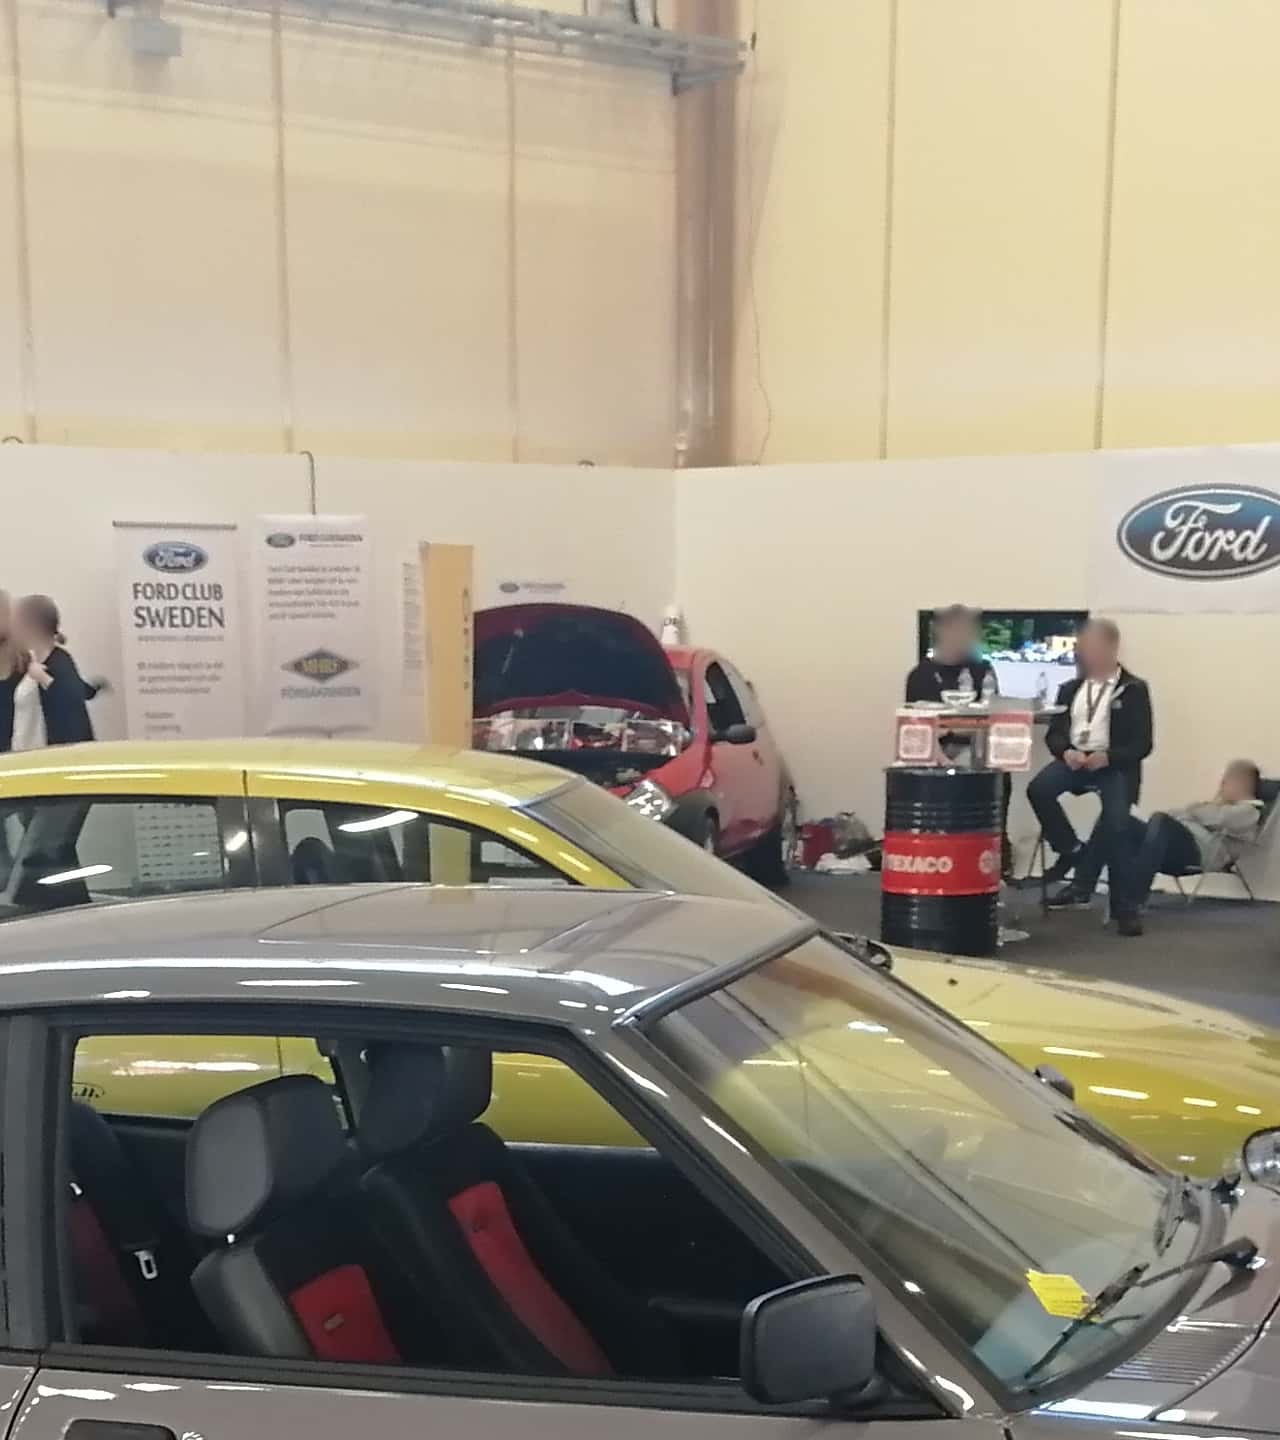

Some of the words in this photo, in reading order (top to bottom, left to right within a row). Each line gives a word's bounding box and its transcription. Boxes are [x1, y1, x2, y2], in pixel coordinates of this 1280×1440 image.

[1151, 499, 1272, 562] Ford
[132, 582, 179, 601] FORD
[181, 582, 224, 601] CLUB
[133, 605, 225, 628] SWEDEN
